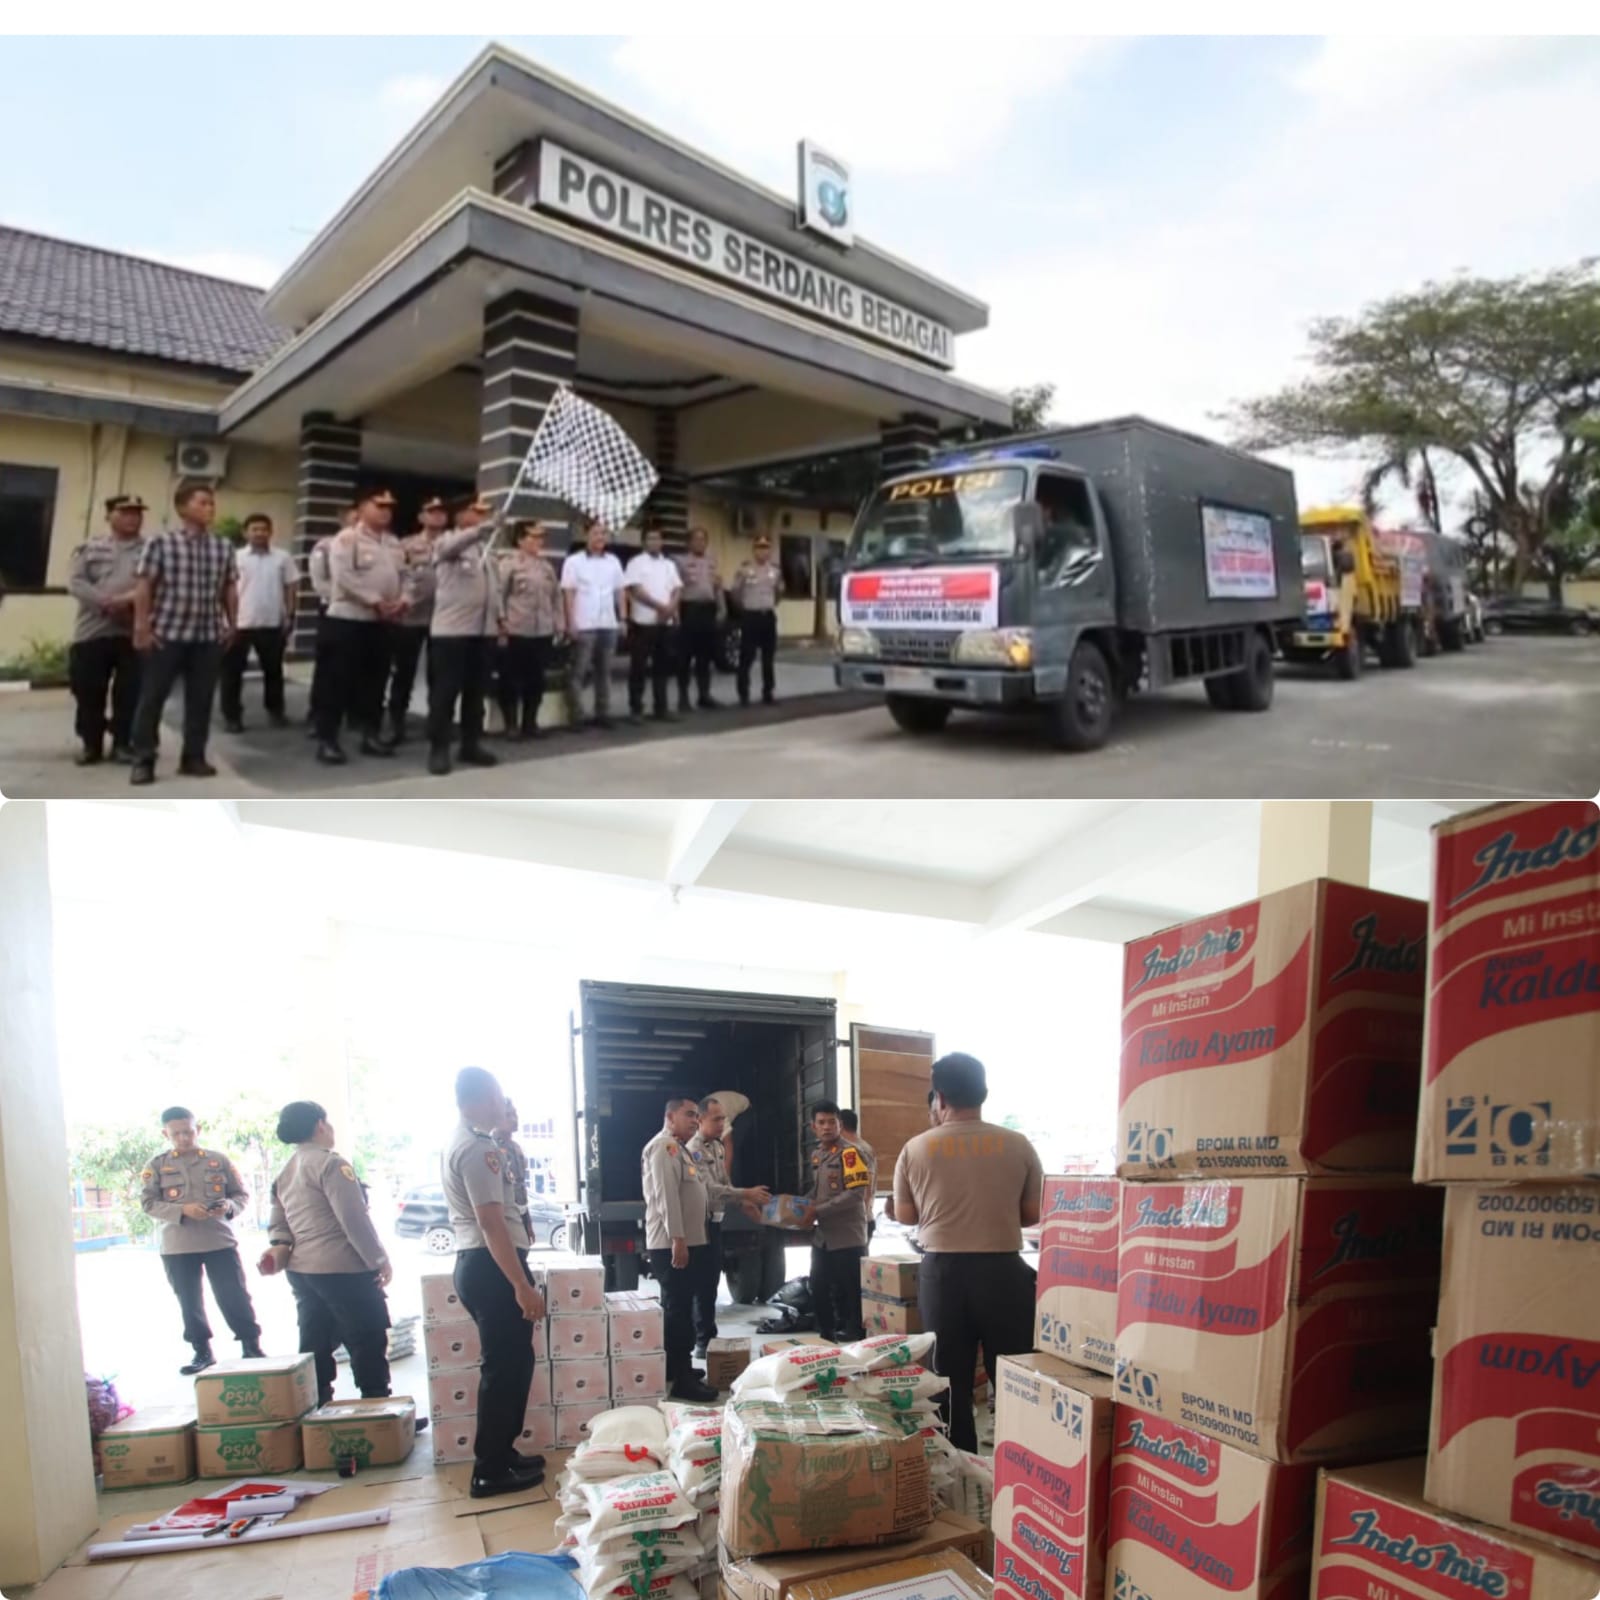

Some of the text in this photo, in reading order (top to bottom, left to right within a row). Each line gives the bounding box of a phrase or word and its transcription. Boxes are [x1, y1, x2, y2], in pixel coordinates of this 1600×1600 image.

[558, 157, 949, 358] POLRES SERDANG BEDAGAI
[889, 471, 997, 501] POLISI
[1448, 821, 1600, 908] Indo
[1503, 902, 1600, 939] Mi Inst
[1329, 913, 1427, 983] Indo
[1152, 995, 1210, 1017] Mi Instan
[1140, 1026, 1276, 1068] Kaldu Ayam
[1127, 1128, 1174, 1163] 40
[1196, 1136, 1280, 1151] BPOM RI MD
[1446, 1101, 1552, 1155] 40
[1492, 1154, 1550, 1167] BKS
[1481, 1220, 1600, 1241] POM RI MD
[1144, 1252, 1196, 1271] Mi Instan
[1134, 1286, 1258, 1328] Kaldu Ayam
[1116, 1363, 1161, 1398] 40
[1480, 1343, 1600, 1389] Ayam
[225, 1391, 259, 1403] PSM
[1181, 1392, 1253, 1426] BPOM RI MD
[223, 1445, 257, 1457] PSM
[1119, 1419, 1209, 1476] Indomie
[1137, 1473, 1150, 1489] Mi
[1151, 1480, 1183, 1508] Instan
[1127, 1503, 1235, 1585] Kaldu Ayam
[1330, 1508, 1509, 1598] Indomie
[998, 1557, 1056, 1600] Indomi
